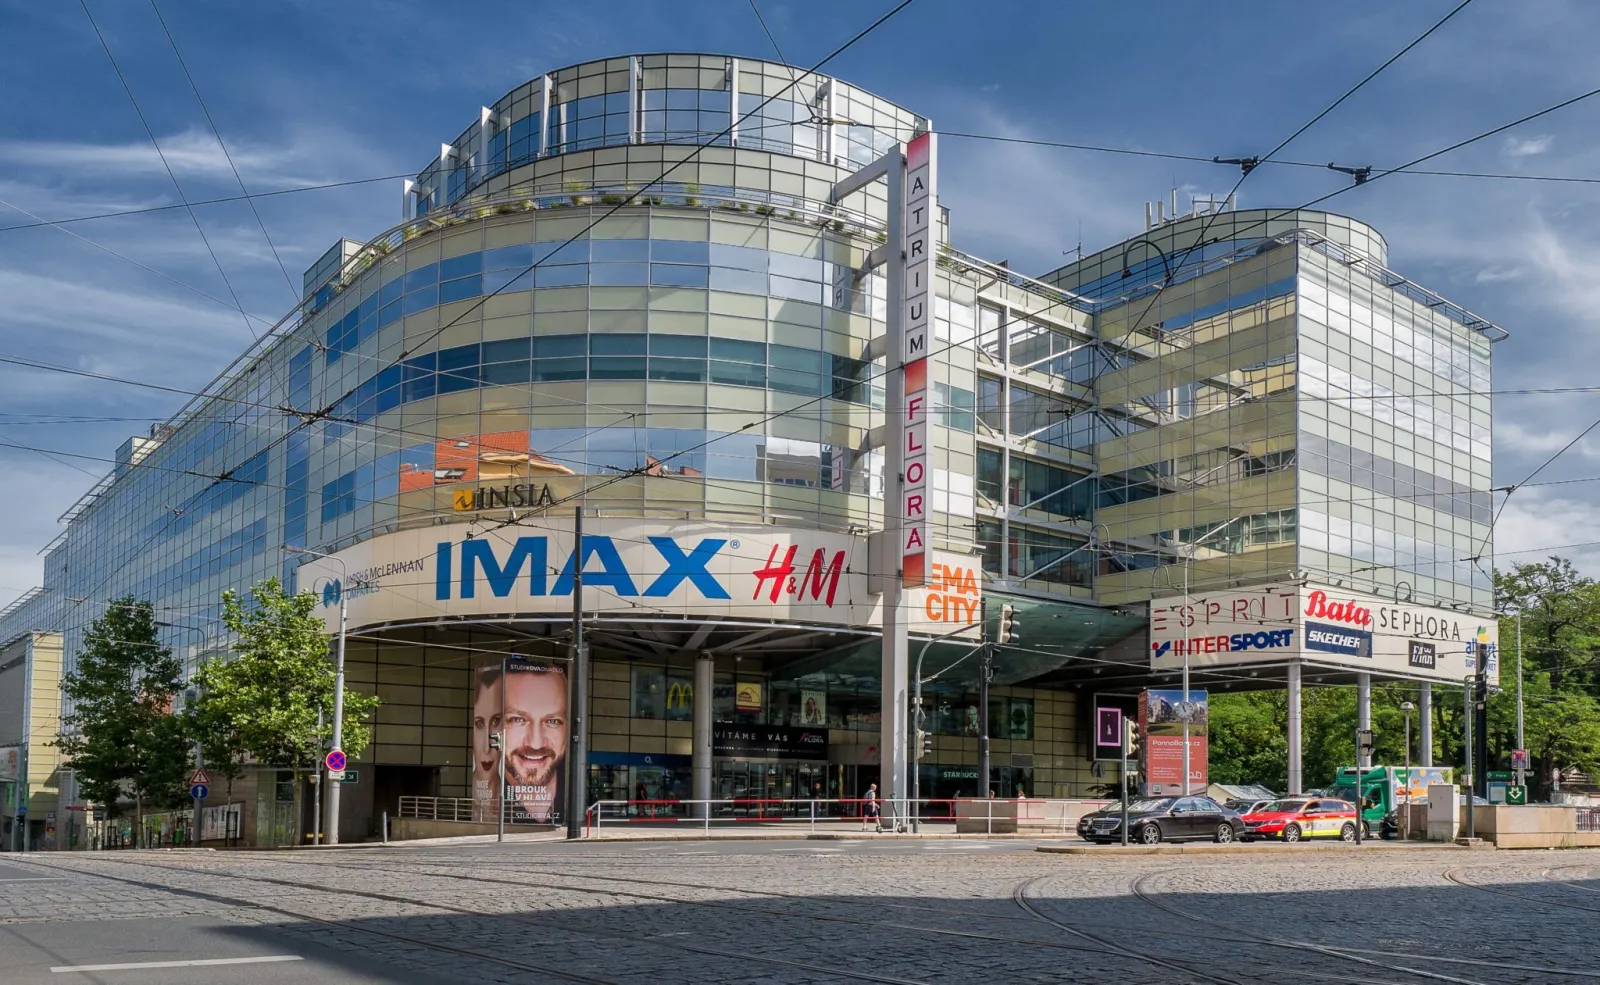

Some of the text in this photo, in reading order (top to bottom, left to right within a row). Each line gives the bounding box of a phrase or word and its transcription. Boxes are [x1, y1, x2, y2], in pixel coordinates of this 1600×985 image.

[910, 176, 924, 354] ATRIUM
[905, 396, 923, 550] FLORA
[478, 482, 556, 510] INSIA
[752, 543, 846, 608] H&M
[926, 593, 979, 625] CITY
[1153, 592, 1295, 631] ESPRIT
[1304, 590, 1372, 627] Bata
[1380, 606, 1460, 641] SEPHORA
[1173, 628, 1294, 657] INTERSPORT
[1308, 630, 1360, 649] SKECHER
[714, 731, 788, 742] VÍTÁME VÁS
[515, 785, 547, 794] BROUK
